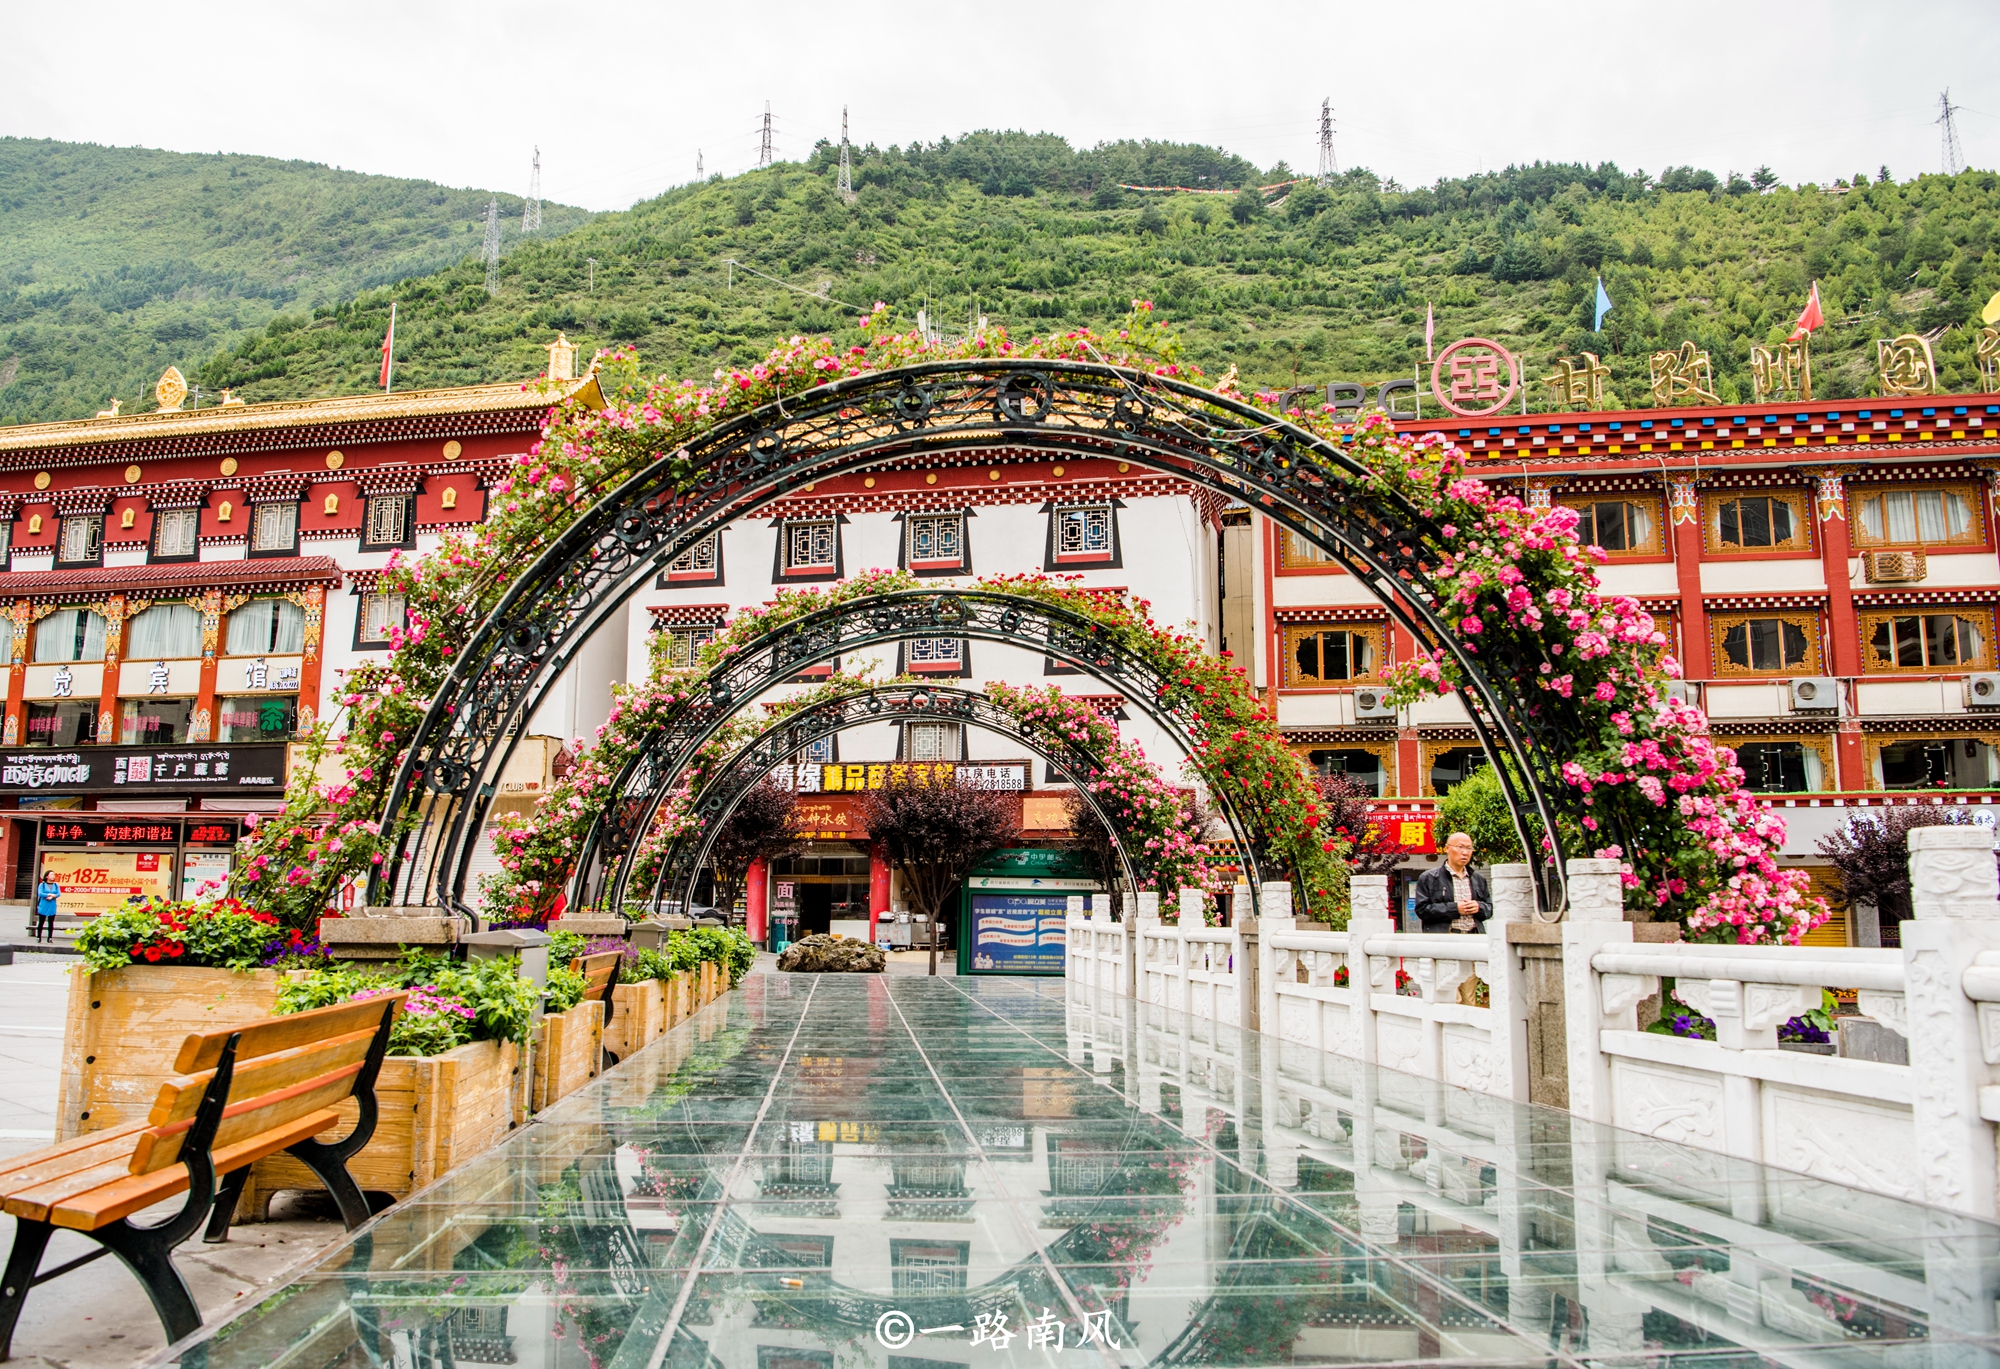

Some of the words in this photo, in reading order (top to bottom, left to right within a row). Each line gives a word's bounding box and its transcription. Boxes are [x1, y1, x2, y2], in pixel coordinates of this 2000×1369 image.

[1261, 378, 1415, 423] CBC
[260, 701, 285, 731] 茶
[504, 782, 523, 791] CLUB
[525, 782, 539, 790] VIP
[104, 826, 173, 840] 构建和谐社
[776, 881, 795, 899] 面
